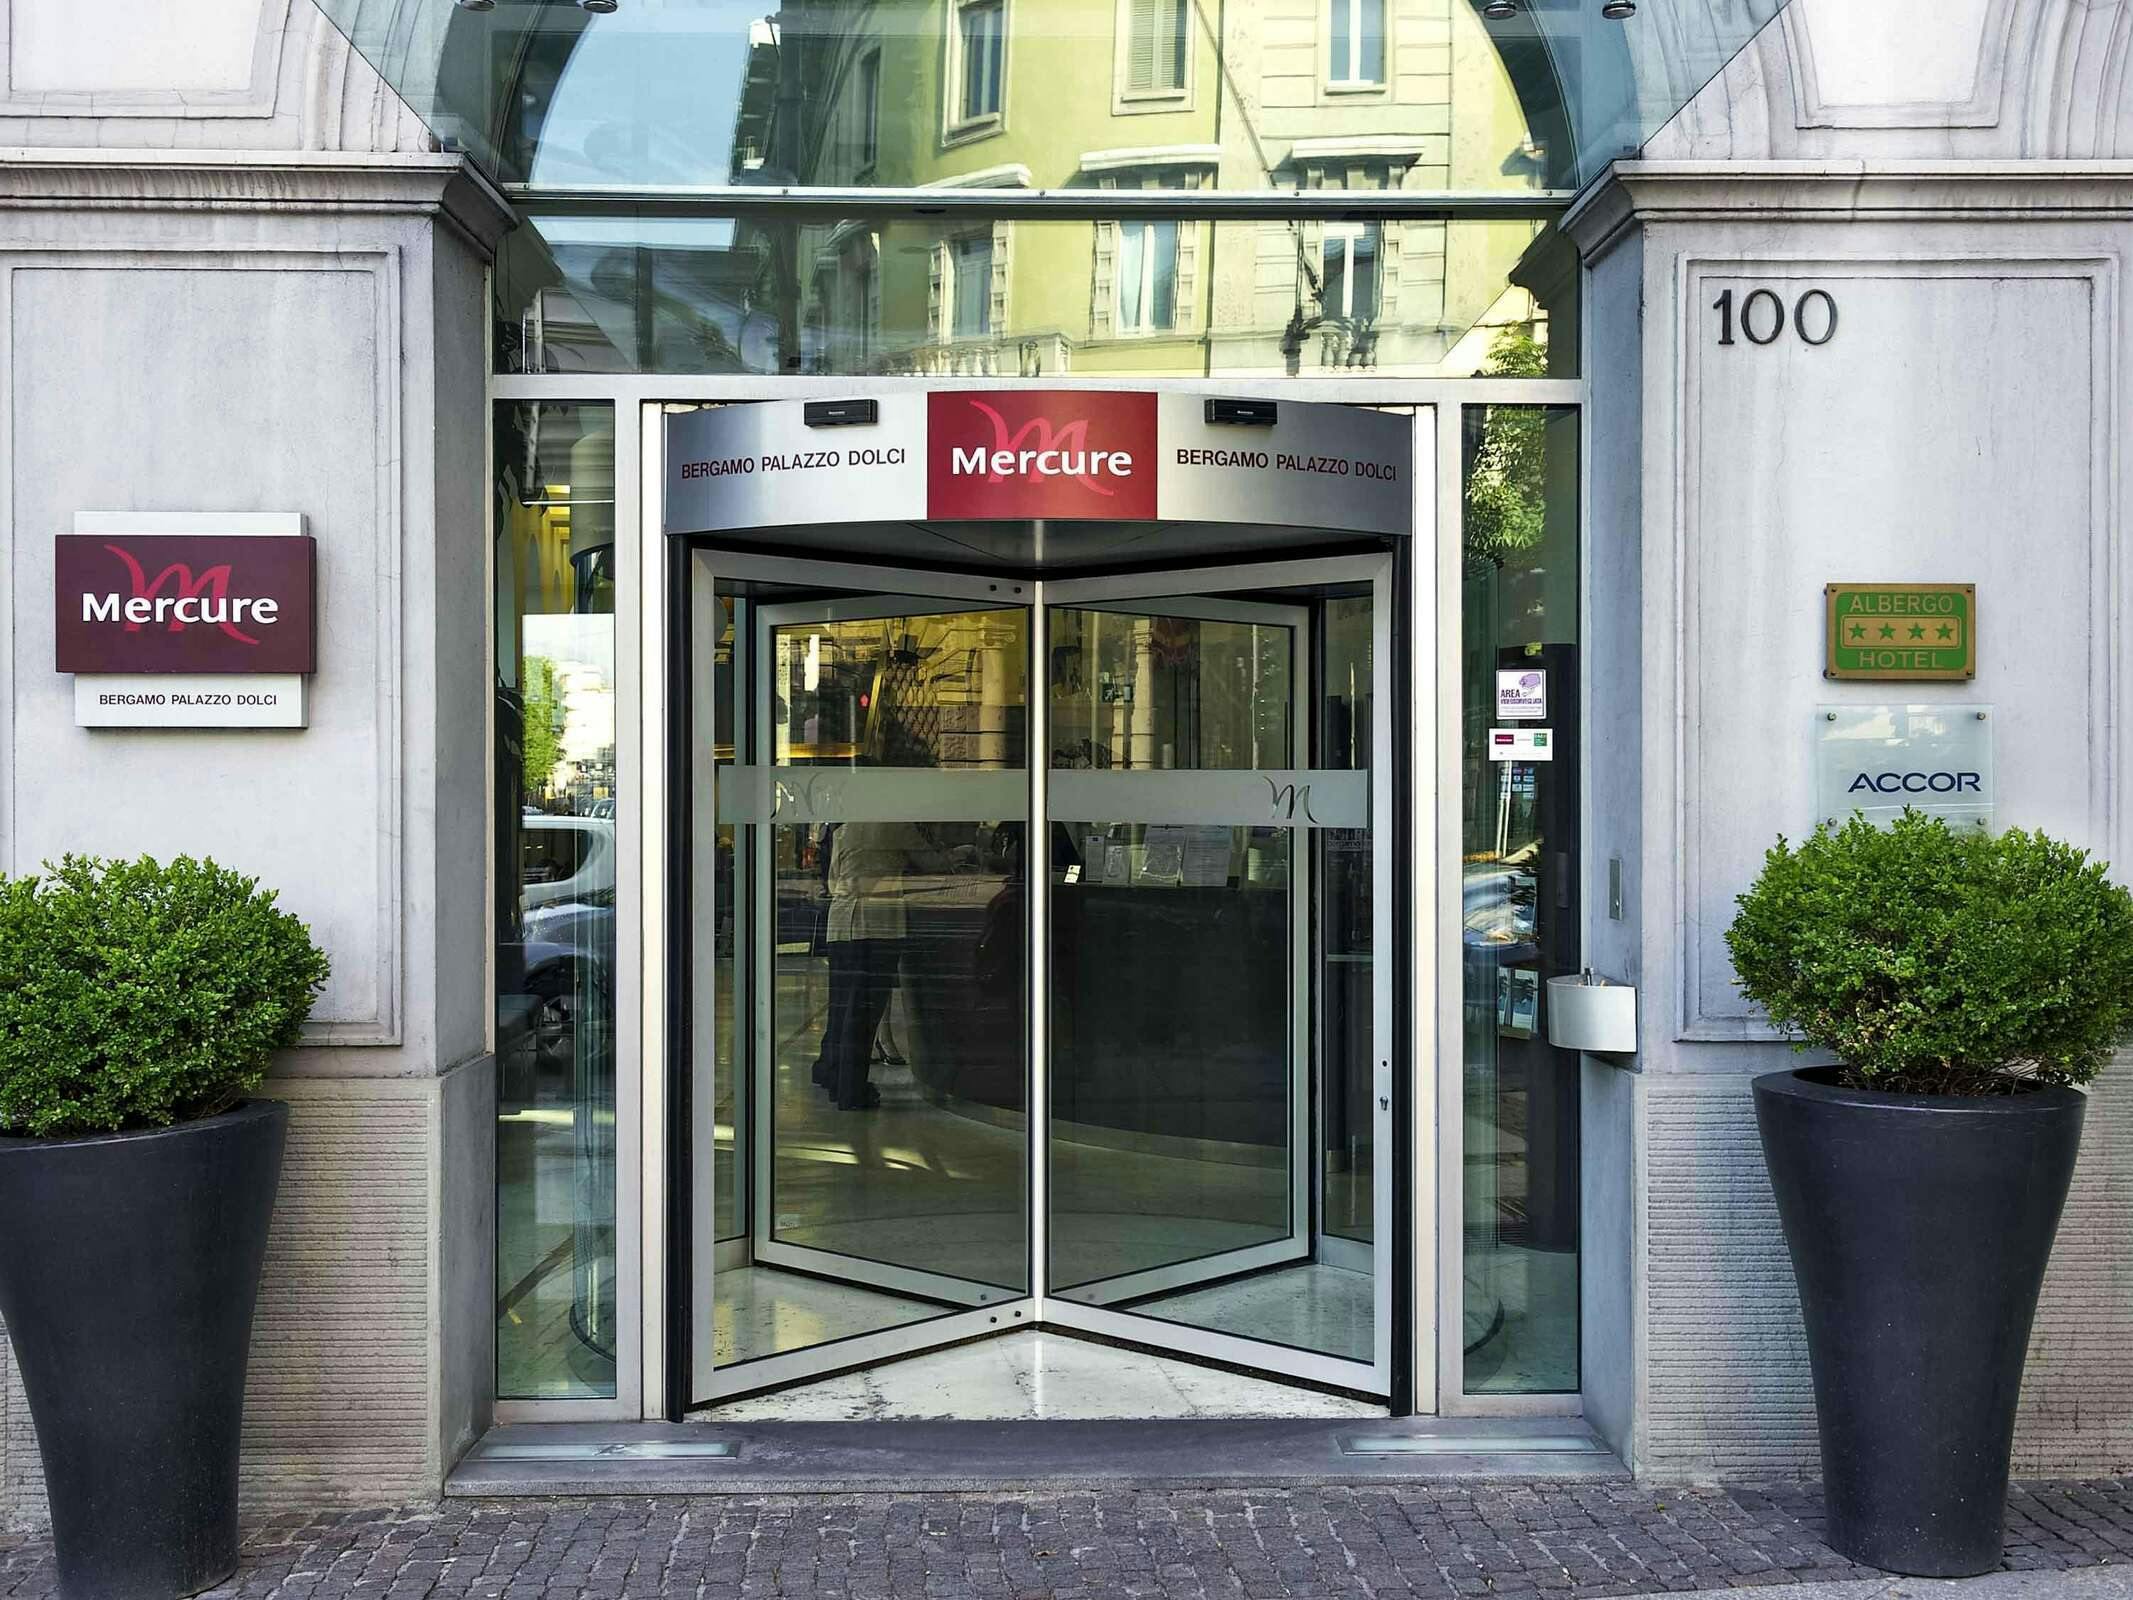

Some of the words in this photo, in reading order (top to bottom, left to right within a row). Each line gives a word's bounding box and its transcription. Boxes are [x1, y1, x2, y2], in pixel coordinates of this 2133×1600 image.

[1712, 288, 1838, 346] 100
[682, 457, 755, 480] BERGAMO
[761, 450, 840, 472] PALAZZO
[848, 447, 905, 467] DOLCI
[952, 447, 1132, 477] Mercure
[1176, 448, 1269, 468] BERGAMO
[1276, 454, 1349, 476] PALAZZO
[1355, 462, 1397, 482] DOLCI
[81, 592, 279, 624] Mercure
[1849, 595, 1954, 613] ALBERGO
[1859, 651, 1944, 669] HOTEL
[99, 694, 166, 706] BERGAMO
[171, 694, 232, 706] PALAZZO
[237, 694, 277, 706] DOLCI
[1500, 689, 1521, 698] AREA
[1847, 772, 1982, 793] ACCOR
